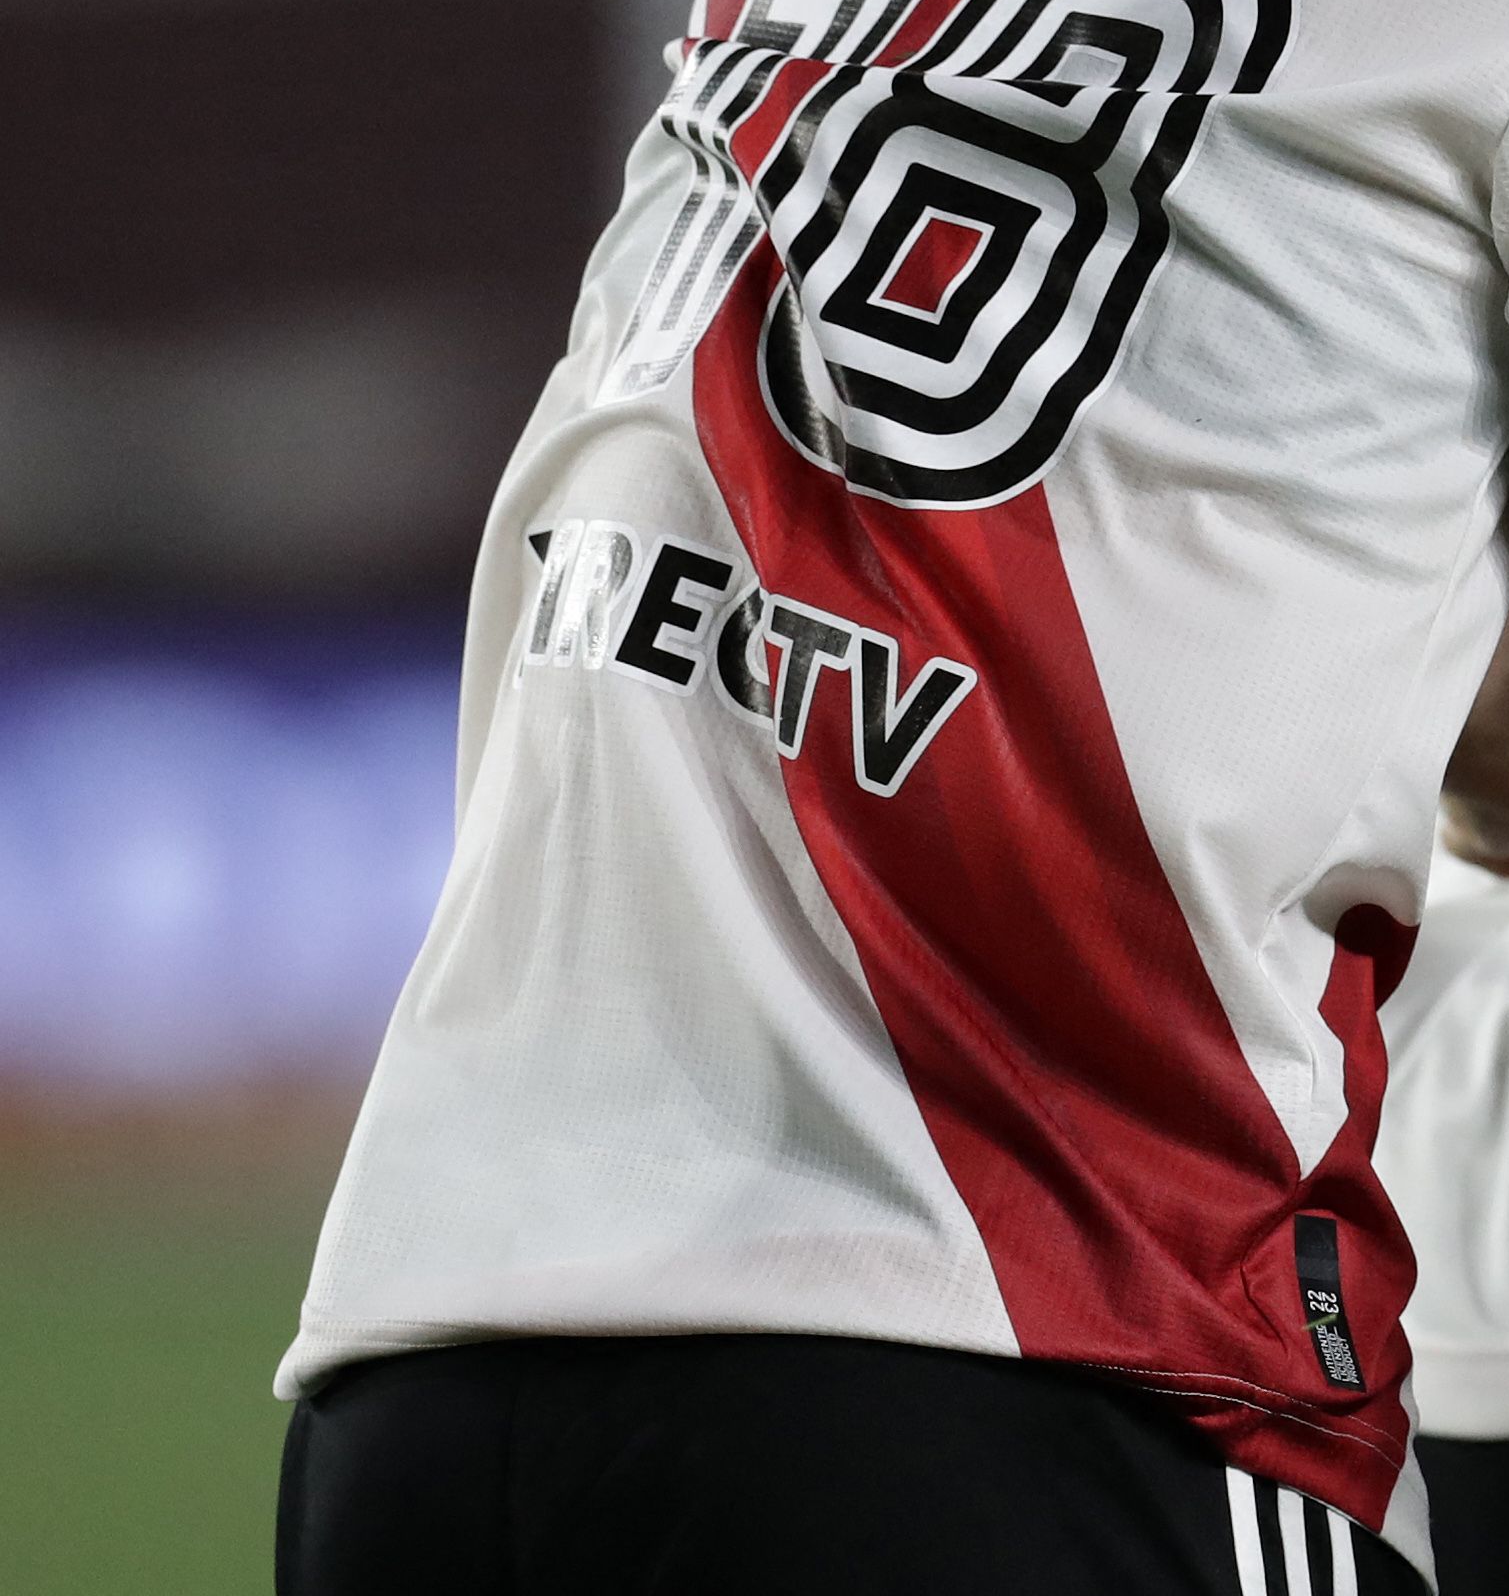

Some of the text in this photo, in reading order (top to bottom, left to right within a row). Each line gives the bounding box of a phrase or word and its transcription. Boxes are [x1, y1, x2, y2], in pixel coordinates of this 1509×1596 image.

[518, 520, 974, 792] IRECTV
[1307, 1290, 1325, 1312] 22
[1321, 1291, 1340, 1314] 23
[1316, 1324, 1342, 1380] AUTHENTIC
